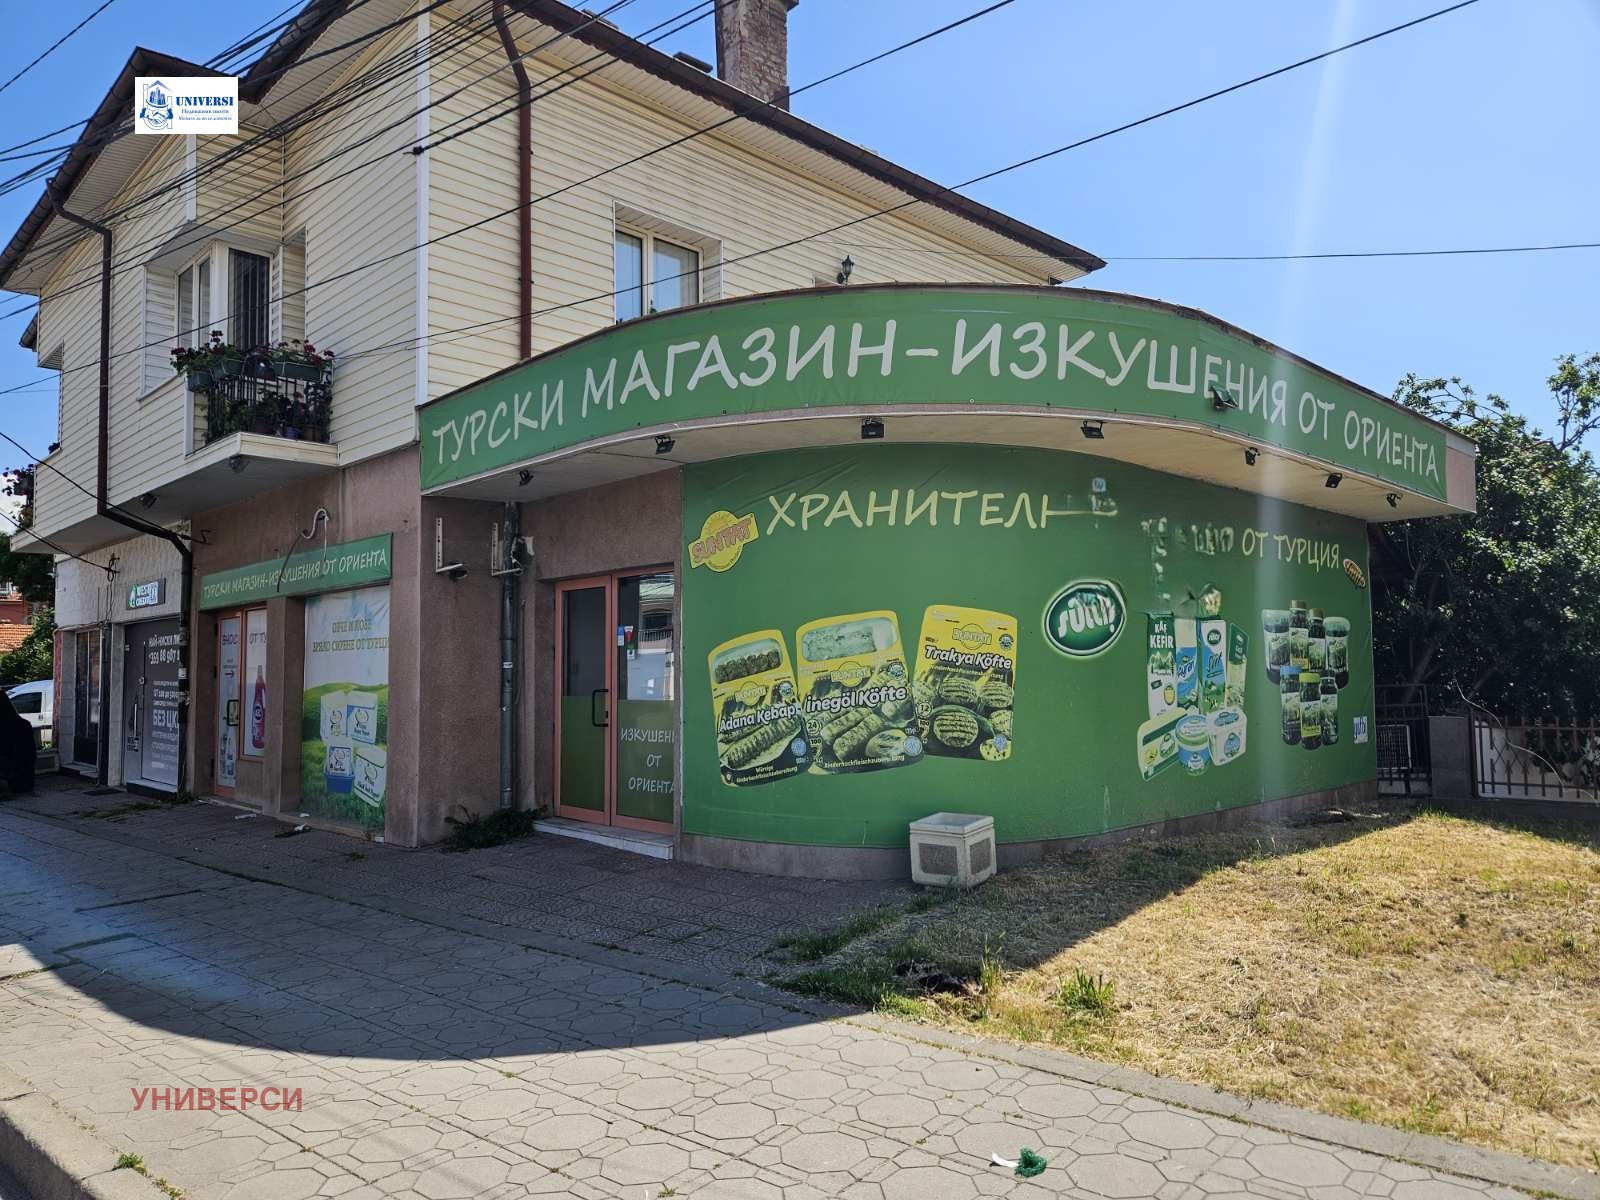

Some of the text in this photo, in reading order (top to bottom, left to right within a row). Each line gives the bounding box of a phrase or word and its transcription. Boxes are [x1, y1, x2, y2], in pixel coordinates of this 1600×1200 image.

[431, 318, 1439, 484] ТУРСКИ МАГАЗИН-ИЗКУШЕНИЯ ОТ ОРИЕНТА
[1242, 527, 1268, 558] ОТ
[1273, 535, 1341, 573] ТУРЦИЯ
[203, 582, 231, 599] ТУРСКИ
[321, 557, 336, 575] ОТ
[338, 549, 387, 573] ОРИЕНТА
[926, 645, 1012, 670] Trakya Köfte
[858, 686, 907, 708] Köfte
[719, 714, 756, 732] Adana
[646, 753, 663, 768] ОТ
